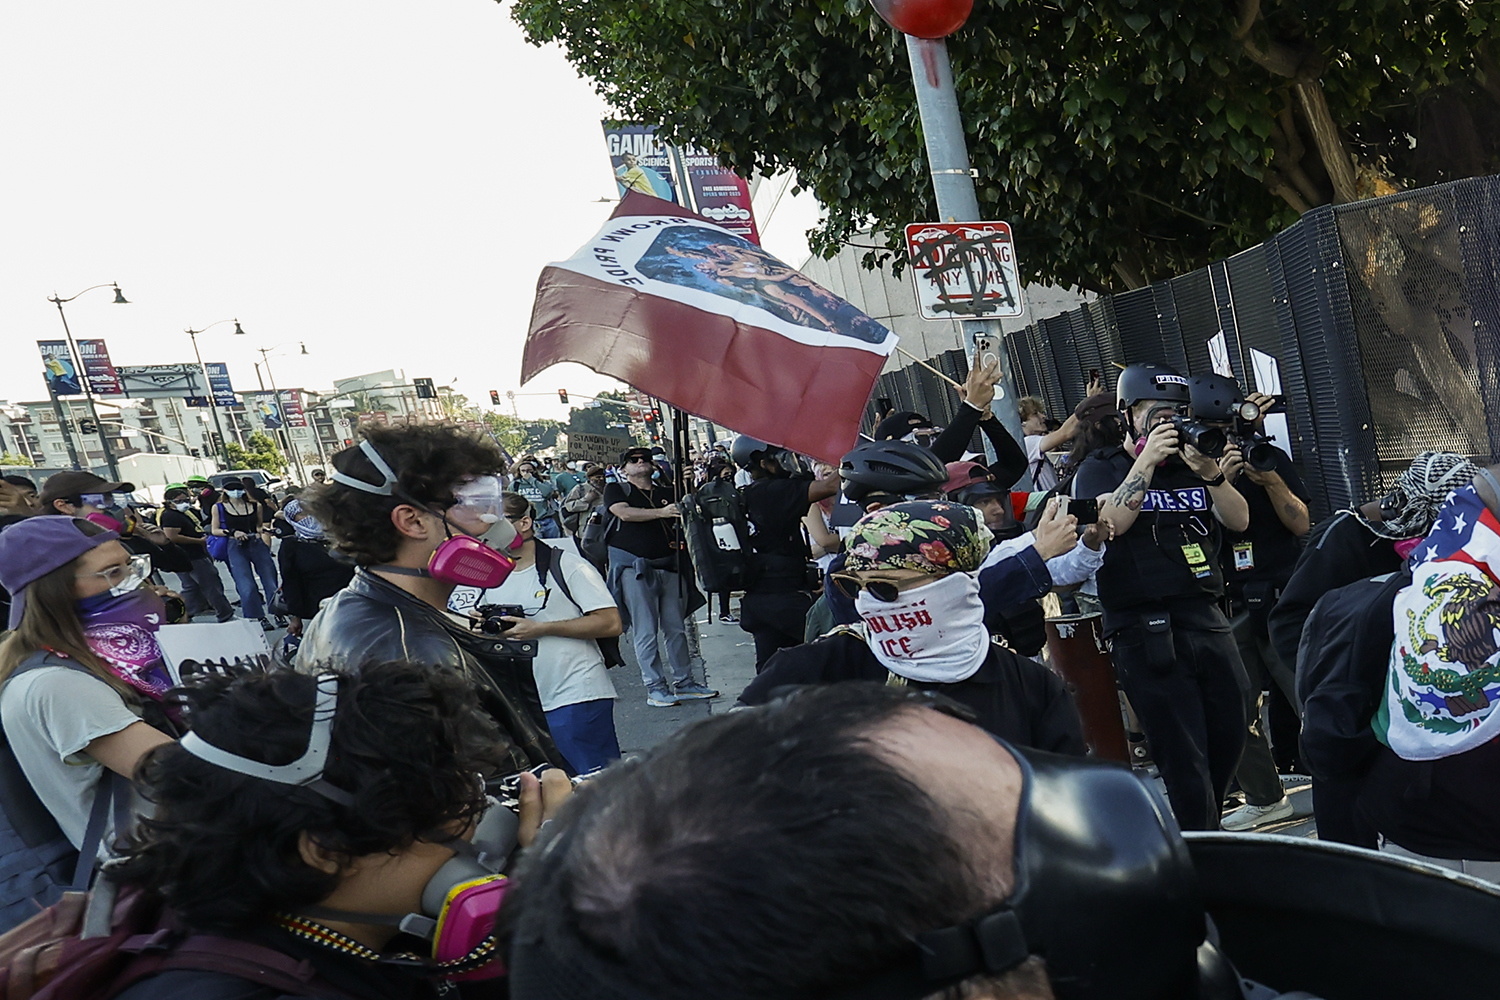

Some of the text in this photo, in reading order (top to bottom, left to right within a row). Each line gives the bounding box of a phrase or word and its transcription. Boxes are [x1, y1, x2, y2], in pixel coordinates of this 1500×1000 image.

[607, 134, 664, 157] GAME
[685, 157, 713, 167] SPORTS
[930, 269, 1005, 287] ANY IME
[39, 344, 69, 356] GAME
[79, 344, 97, 355] ON!
[1140, 489, 1204, 510] PRESS
[879, 637, 913, 658] ICE
